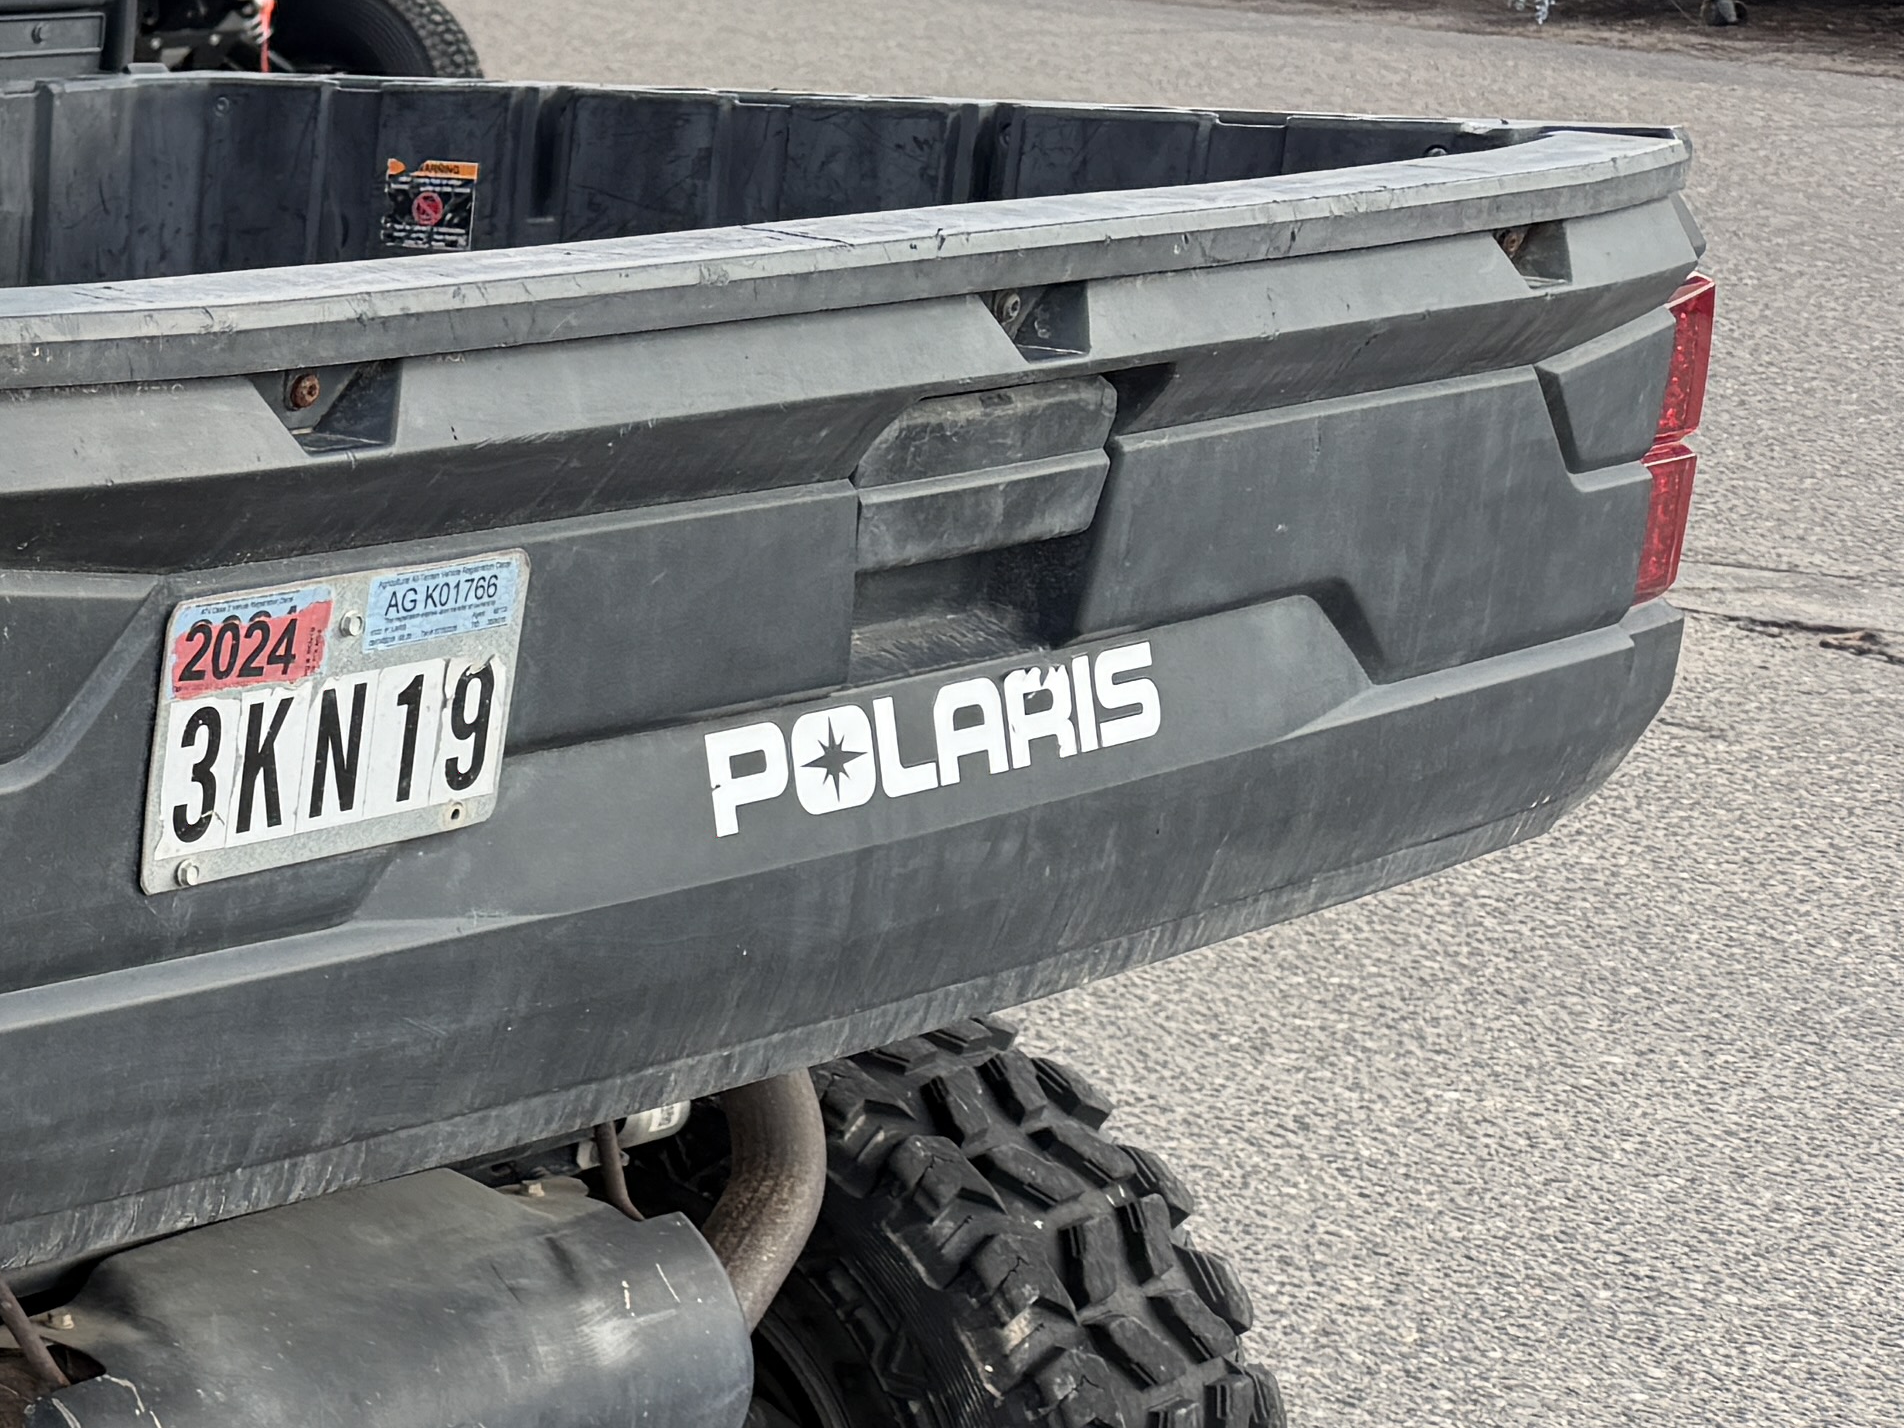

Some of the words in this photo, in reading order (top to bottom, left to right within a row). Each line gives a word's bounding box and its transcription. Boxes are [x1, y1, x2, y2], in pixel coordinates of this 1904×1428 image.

[178, 618, 299, 682] 2024
[384, 587, 418, 616] AG
[424, 574, 499, 610] K01766
[172, 663, 497, 844] 3KN19
[703, 640, 1162, 838] POLARIS
